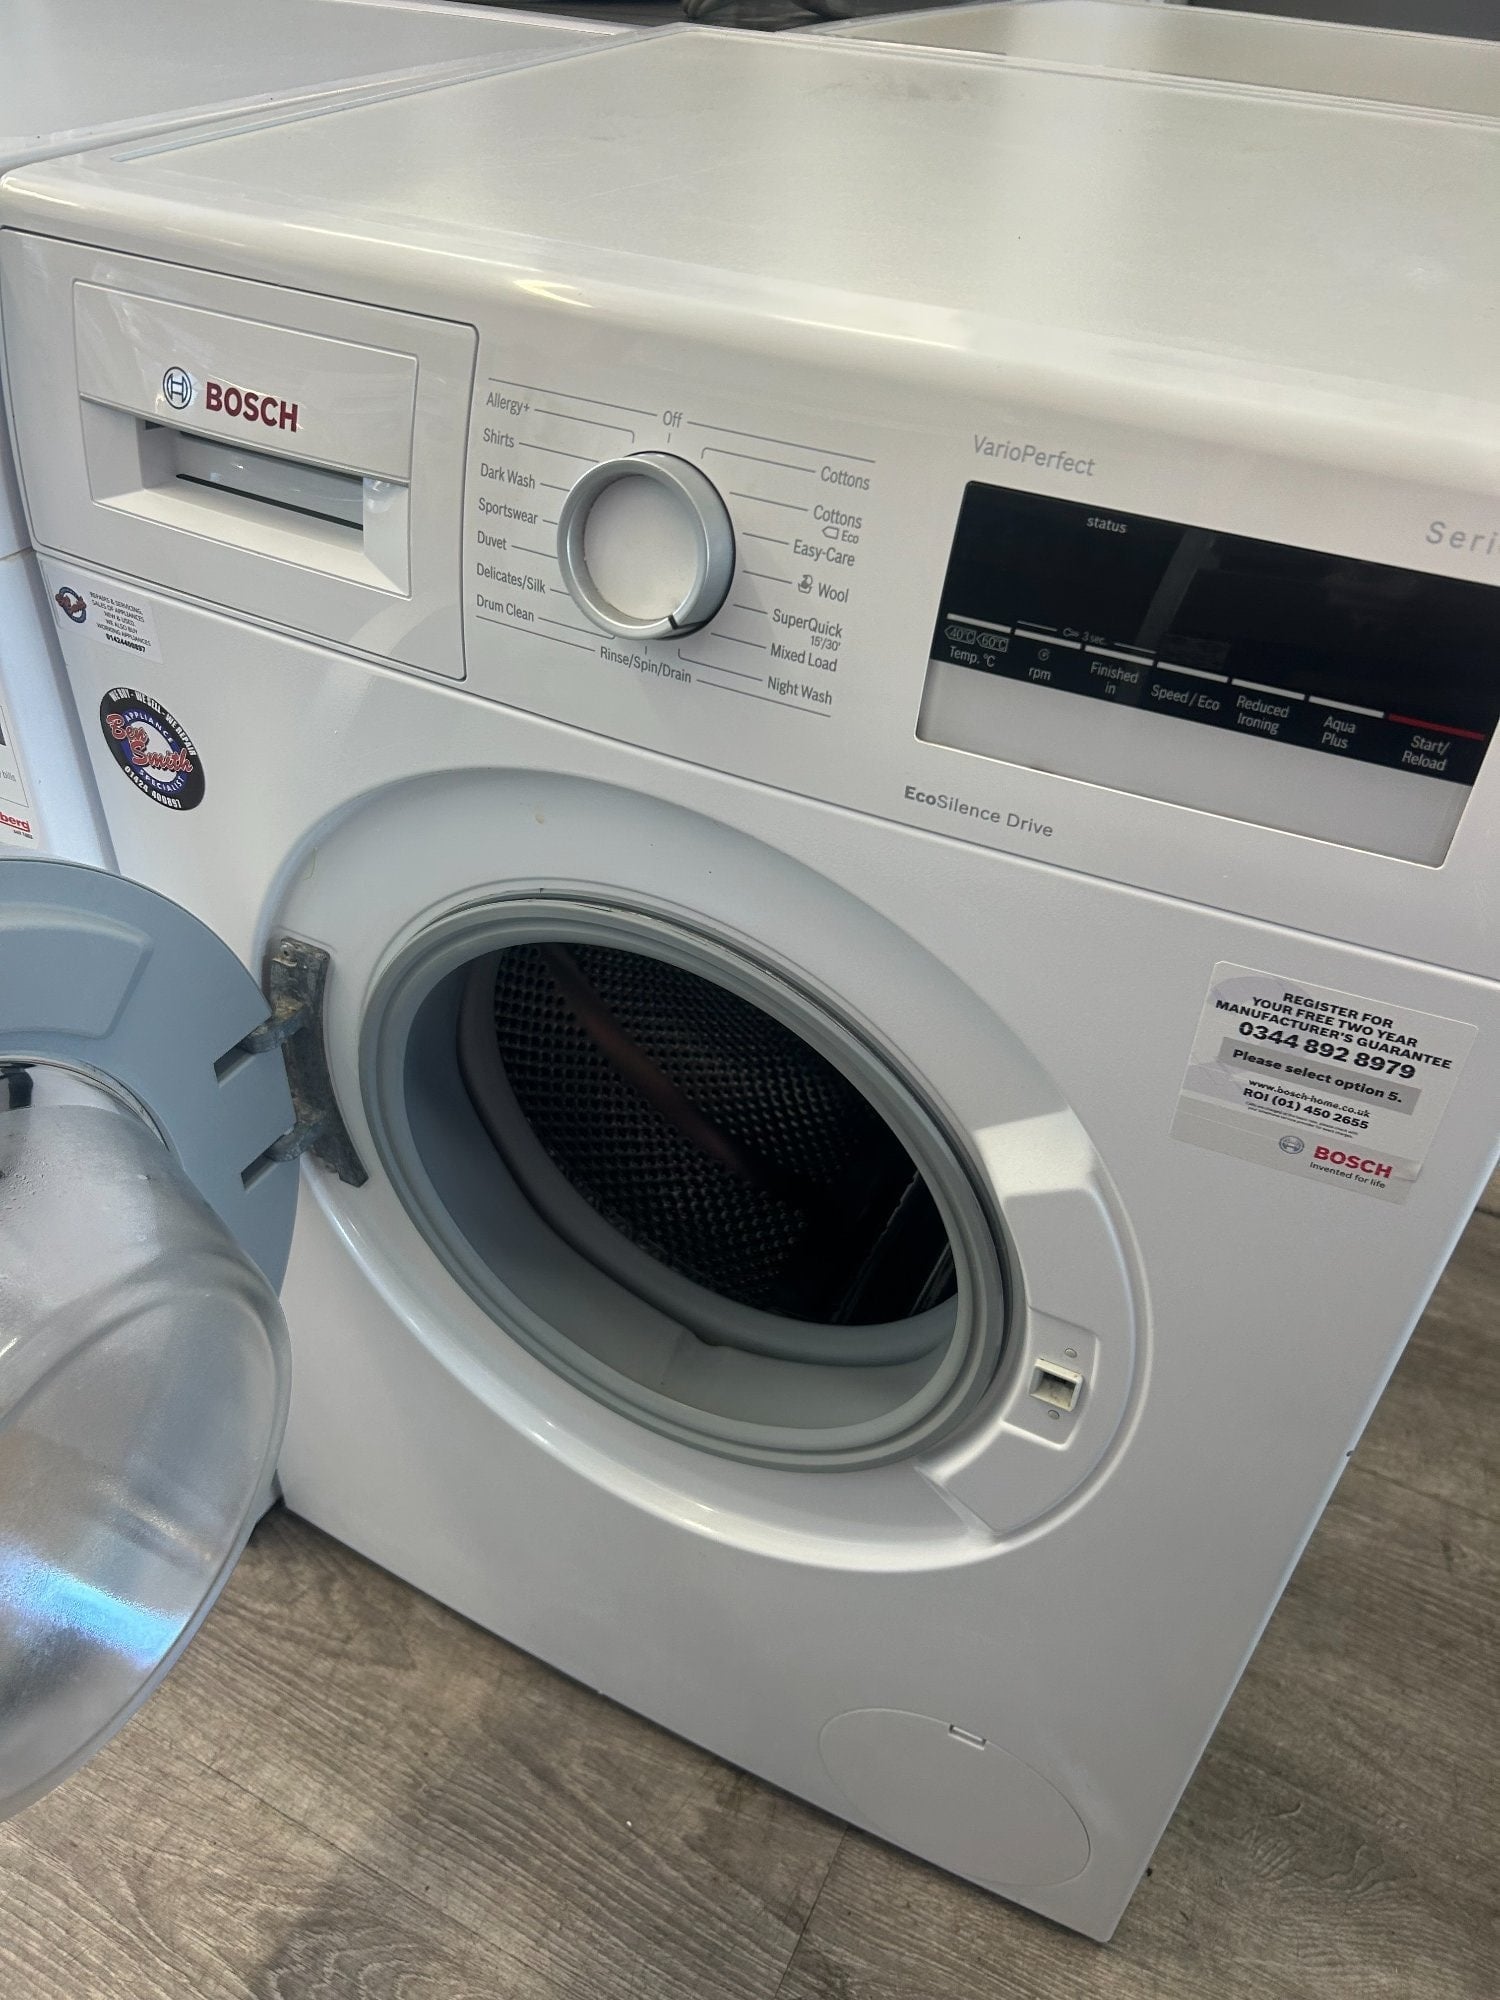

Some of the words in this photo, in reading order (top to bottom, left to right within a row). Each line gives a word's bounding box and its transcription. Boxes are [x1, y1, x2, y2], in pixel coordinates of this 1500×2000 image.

[206, 382, 298, 432] BOSCH
[487, 392, 530, 415] Allergy+
[663, 411, 682, 428] Off
[483, 428, 515, 448] Shirts
[974, 435, 1095, 477] VarioPerfect
[481, 463, 504, 482] Dark
[507, 470, 535, 489] Wash
[821, 466, 870, 490] Cottons
[478, 498, 538, 525] Sportswear
[813, 504, 861, 529] Cottons
[1087, 515, 1127, 534] status
[477, 531, 506, 551] Duvet
[841, 530, 859, 544] Eco
[794, 539, 855, 566] Easy-Care
[477, 563, 545, 593] Delicates/Silk
[818, 583, 849, 603] Wool
[477, 595, 504, 614] Drum
[506, 603, 534, 621] Clean
[772, 609, 842, 638] SuperQuick
[600, 646, 691, 683] Rinse/Spin/Drain
[770, 643, 805, 664] Mixed
[808, 653, 837, 672] Load
[950, 646, 980, 665] Temp.
[983, 653, 995, 667] °C
[1028, 667, 1050, 681] rpm
[1090, 661, 1138, 684] Finished
[768, 675, 799, 698] Night
[801, 684, 832, 705] Wash
[1105, 682, 1116, 695] in
[1151, 685, 1187, 704] Speed
[1198, 696, 1220, 711] Eco
[1237, 694, 1290, 720] Reduced
[106, 713, 148, 742] Ben
[1237, 712, 1279, 736] Ironing
[1324, 715, 1356, 736] Aqua
[1322, 731, 1349, 750] Plus
[1410, 734, 1448, 756] Start/
[130, 740, 193, 772] Smith
[1402, 750, 1447, 773] Reload
[139, 769, 184, 792] SPECIALIST
[904, 785, 1000, 824] EcoSilence
[1007, 811, 1053, 838] Drive
[1252, 997, 1292, 1016] YOUR
[1296, 1008, 1335, 1027] FREE
[1339, 1019, 1373, 1036] TWO
[1377, 1029, 1418, 1047] YEAR
[1283, 992, 1358, 1021] REGISTER
[1362, 1013, 1393, 1029] FOR
[1216, 1000, 1353, 1042] MANUFACTURER'S
[1356, 1037, 1452, 1069] GUARANTEE
[1239, 1021, 1299, 1049] 0344
[1303, 1039, 1347, 1063] 892
[1354, 1052, 1416, 1079] 8979
[1233, 1049, 1282, 1070] Please
[1285, 1064, 1331, 1084] select
[1334, 1076, 1384, 1099] option
[1387, 1091, 1402, 1103] 5.
[1243, 1088, 1269, 1103] ROI
[1272, 1096, 1300, 1112] (01)
[1304, 1105, 1330, 1119] 450
[1333, 1113, 1369, 1129] 2655
[1248, 1079, 1370, 1118] www.bosch-home.co.uk
[1310, 1161, 1353, 1179] Invented
[1354, 1174, 1368, 1184] for
[1370, 1178, 1386, 1189] life
[1313, 1146, 1393, 1179] BOSCH
